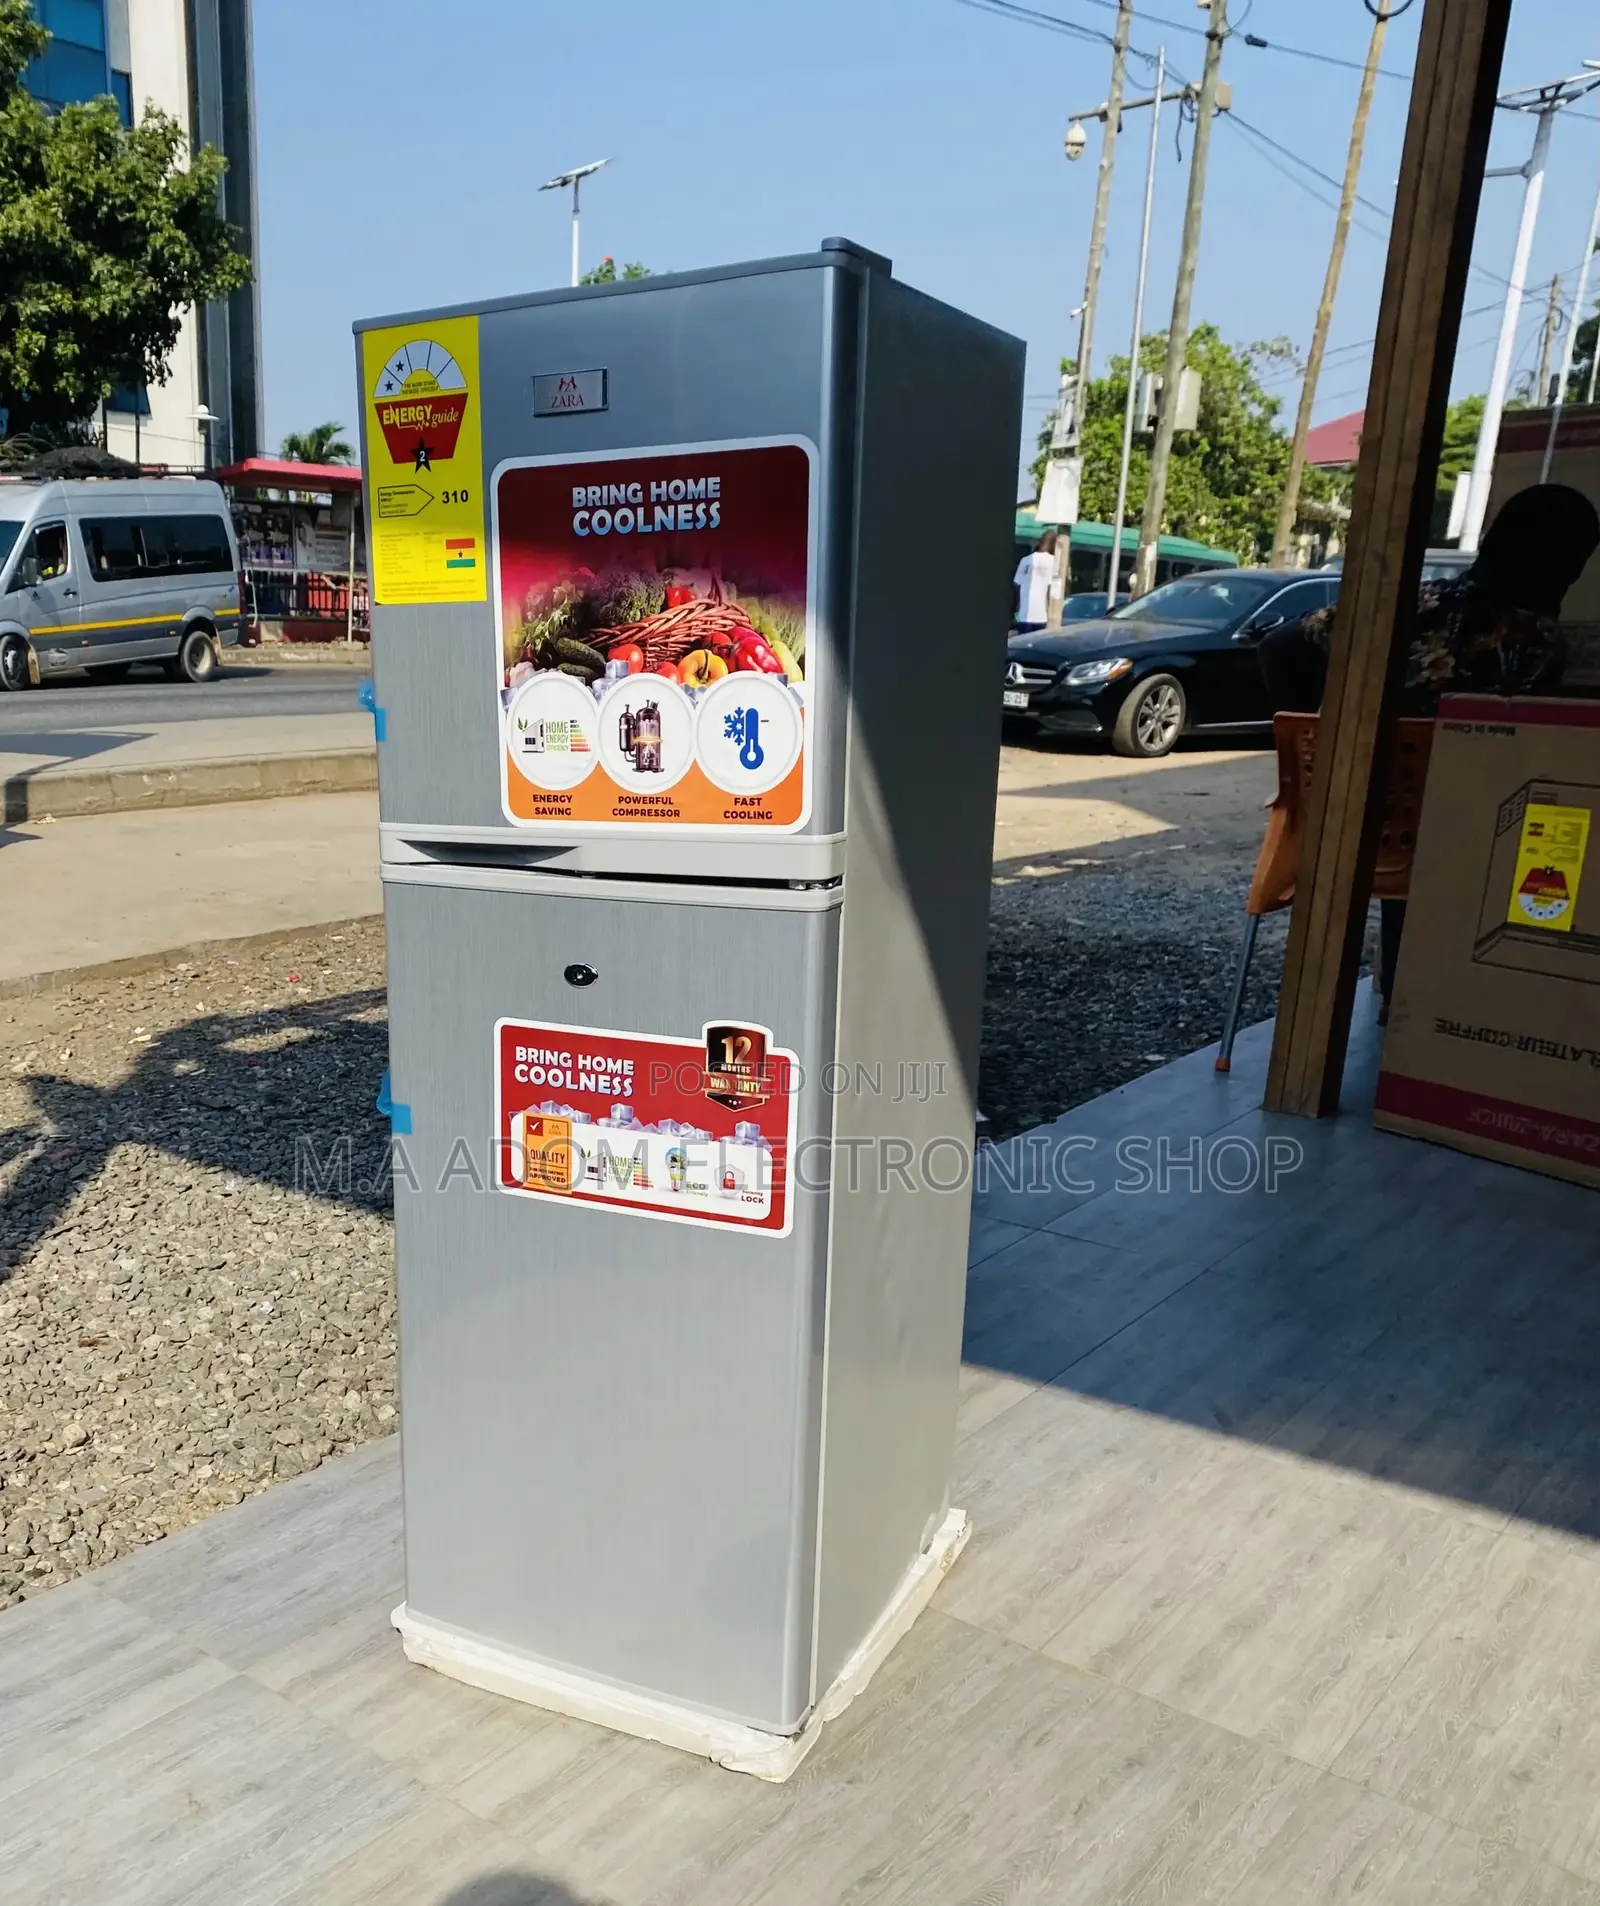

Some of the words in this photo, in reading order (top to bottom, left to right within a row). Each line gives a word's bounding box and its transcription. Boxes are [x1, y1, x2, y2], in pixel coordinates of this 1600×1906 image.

[551, 393, 584, 409] ZARA
[383, 404, 433, 427] ENERGY
[431, 406, 459, 428] guide
[419, 450, 426, 462] 2
[441, 489, 469, 504] 310
[572, 482, 644, 508] BRING
[650, 476, 721, 503] HOME
[572, 501, 721, 537] COOLNESS
[545, 721, 569, 734] HOME
[545, 734, 569, 744] ENERGY
[532, 794, 573, 804] ENERGY
[617, 795, 674, 806] POWERFUL
[733, 797, 763, 807] FAST
[534, 806, 572, 816] SAVING
[612, 807, 681, 818] COMPRESSOR
[723, 810, 773, 820] COOLING
[721, 1036, 752, 1064] 12
[515, 1046, 573, 1068] BRING
[577, 1054, 635, 1076] HOME
[720, 1063, 751, 1074] MONTHS
[514, 1063, 633, 1097] COOLNESS
[530, 1149, 565, 1165] QUALITY
[608, 1155, 633, 1169] HOME
[529, 1172, 566, 1184] APPROVED
[741, 1195, 765, 1205] LOCK
